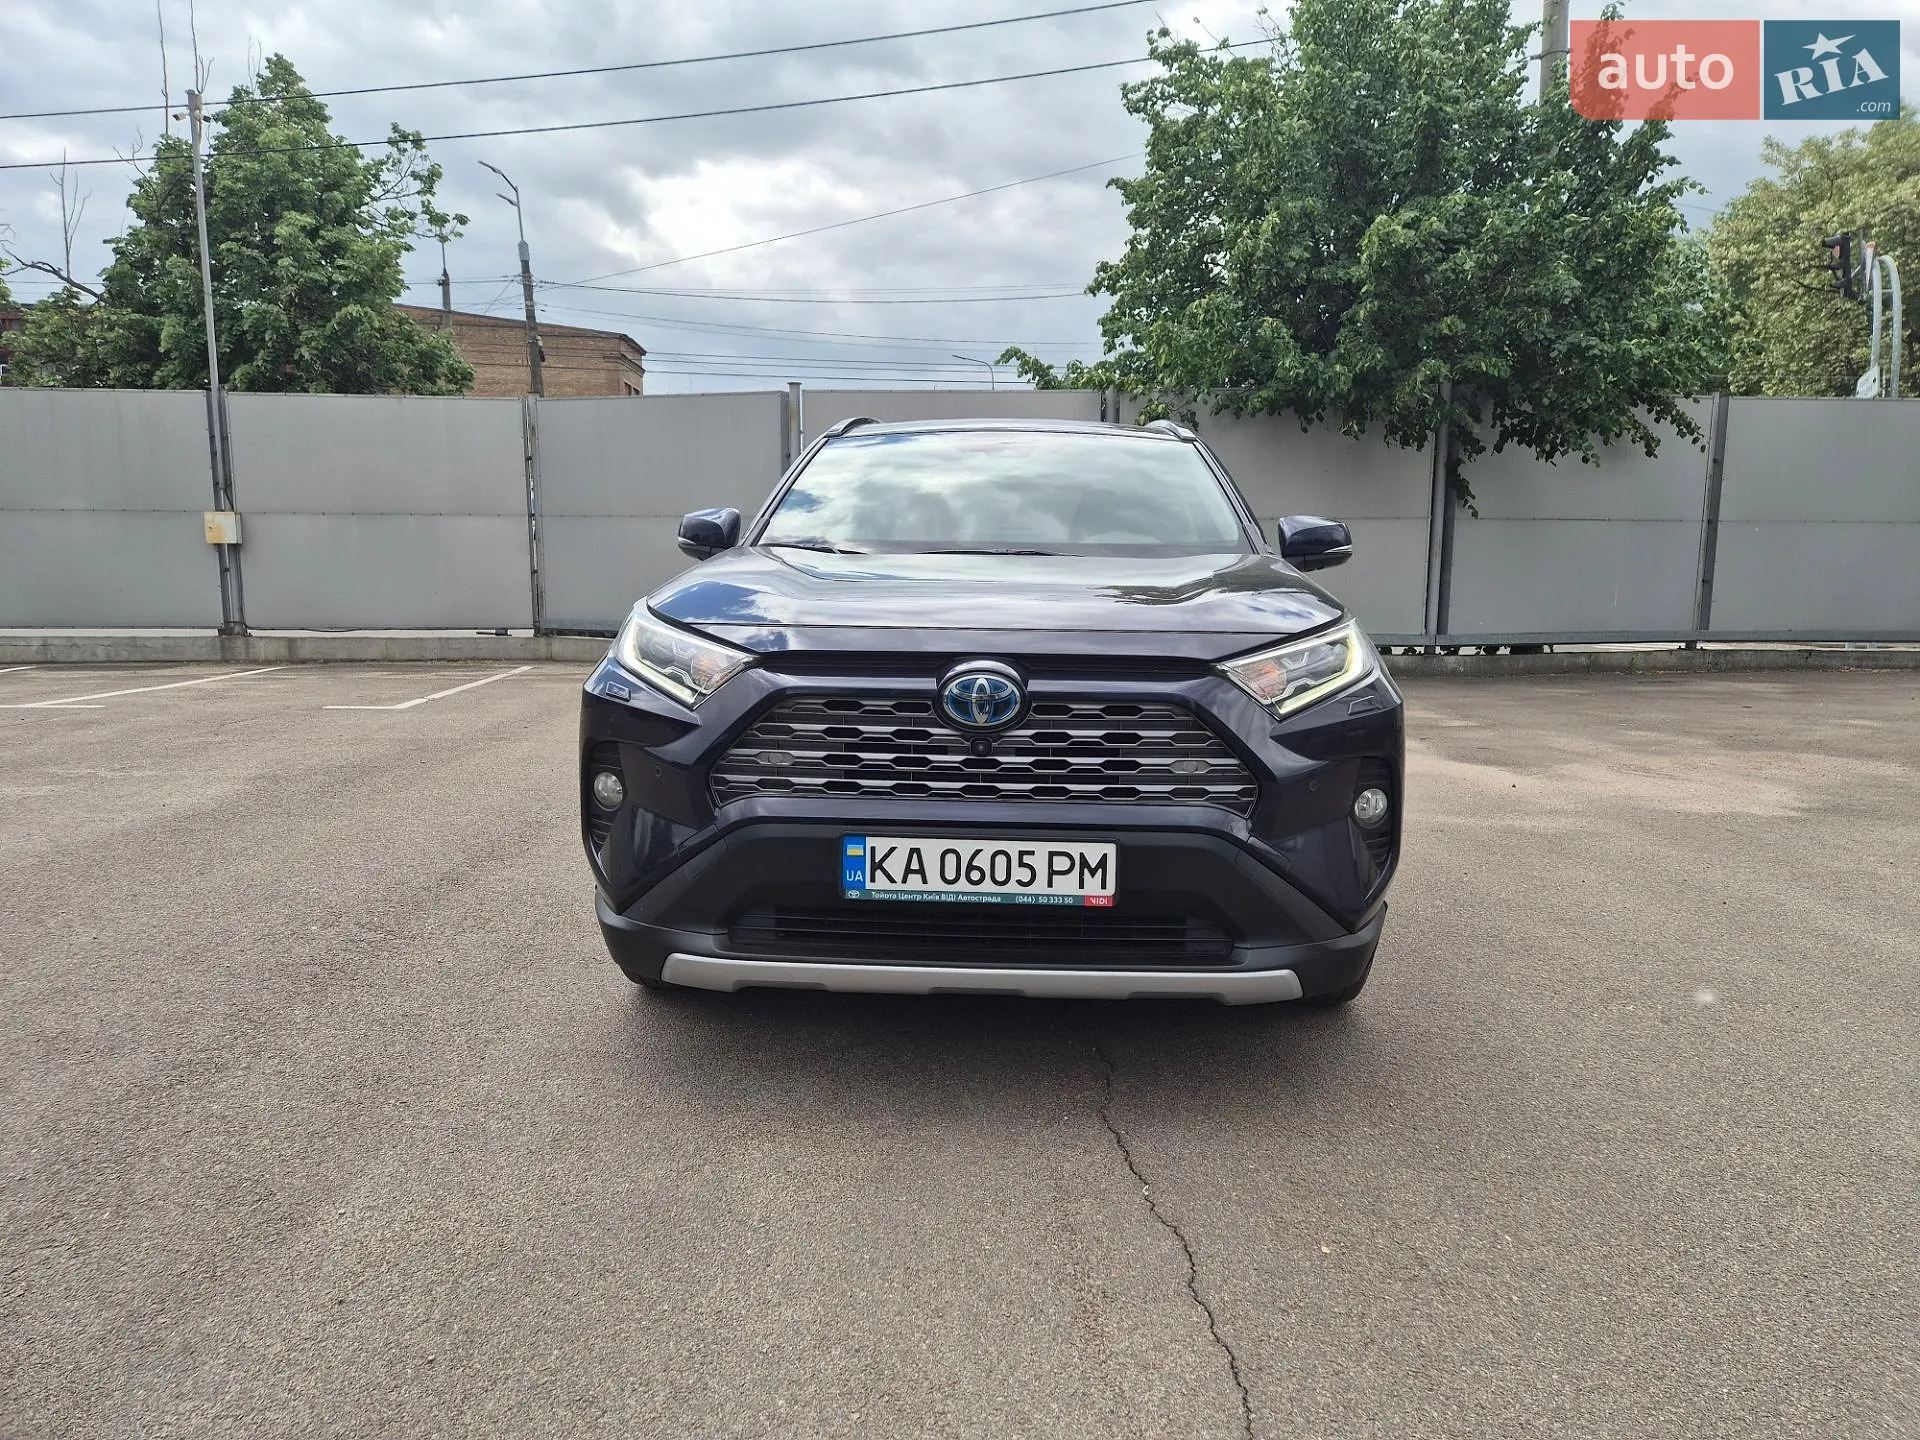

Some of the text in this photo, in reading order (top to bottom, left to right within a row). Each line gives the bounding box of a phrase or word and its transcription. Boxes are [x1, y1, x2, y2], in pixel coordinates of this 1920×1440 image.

[869, 845, 1108, 890] KA 0605 PM
[846, 870, 864, 882] UA
[898, 892, 922, 901] Центр
[1015, 895, 1036, 904] (044)
[1089, 897, 1108, 905] VIDI
